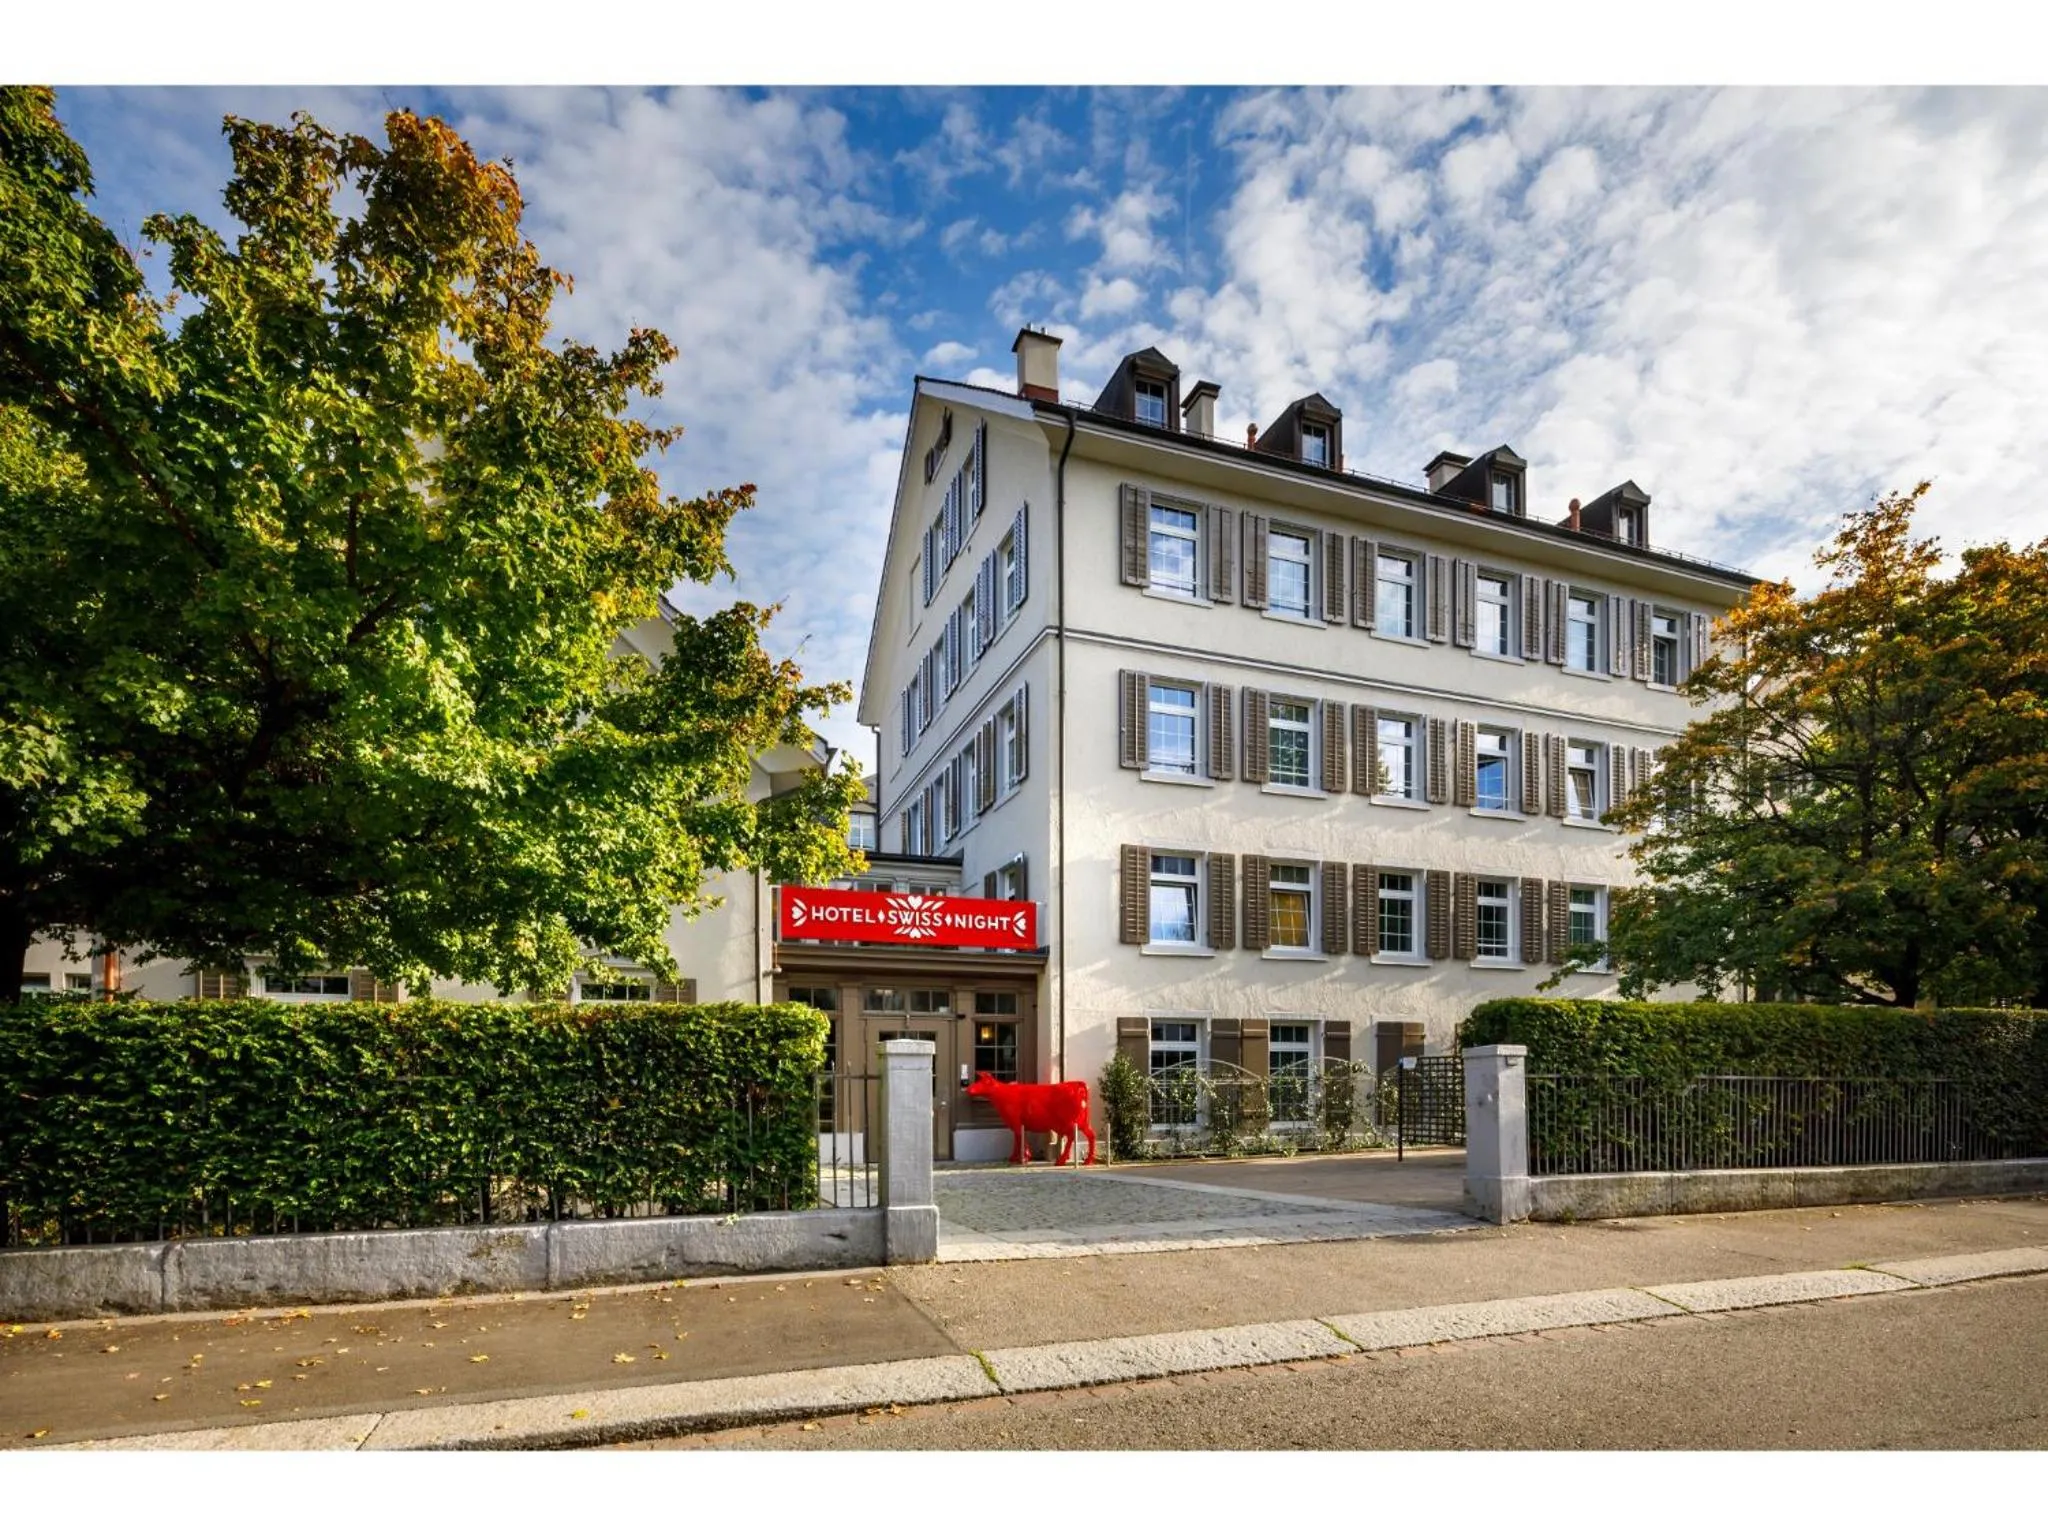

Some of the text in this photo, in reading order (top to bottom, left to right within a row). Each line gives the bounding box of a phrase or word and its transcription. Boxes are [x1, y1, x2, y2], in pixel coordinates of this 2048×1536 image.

[811, 906, 1011, 931] HOTEL SWISS NIGHT
